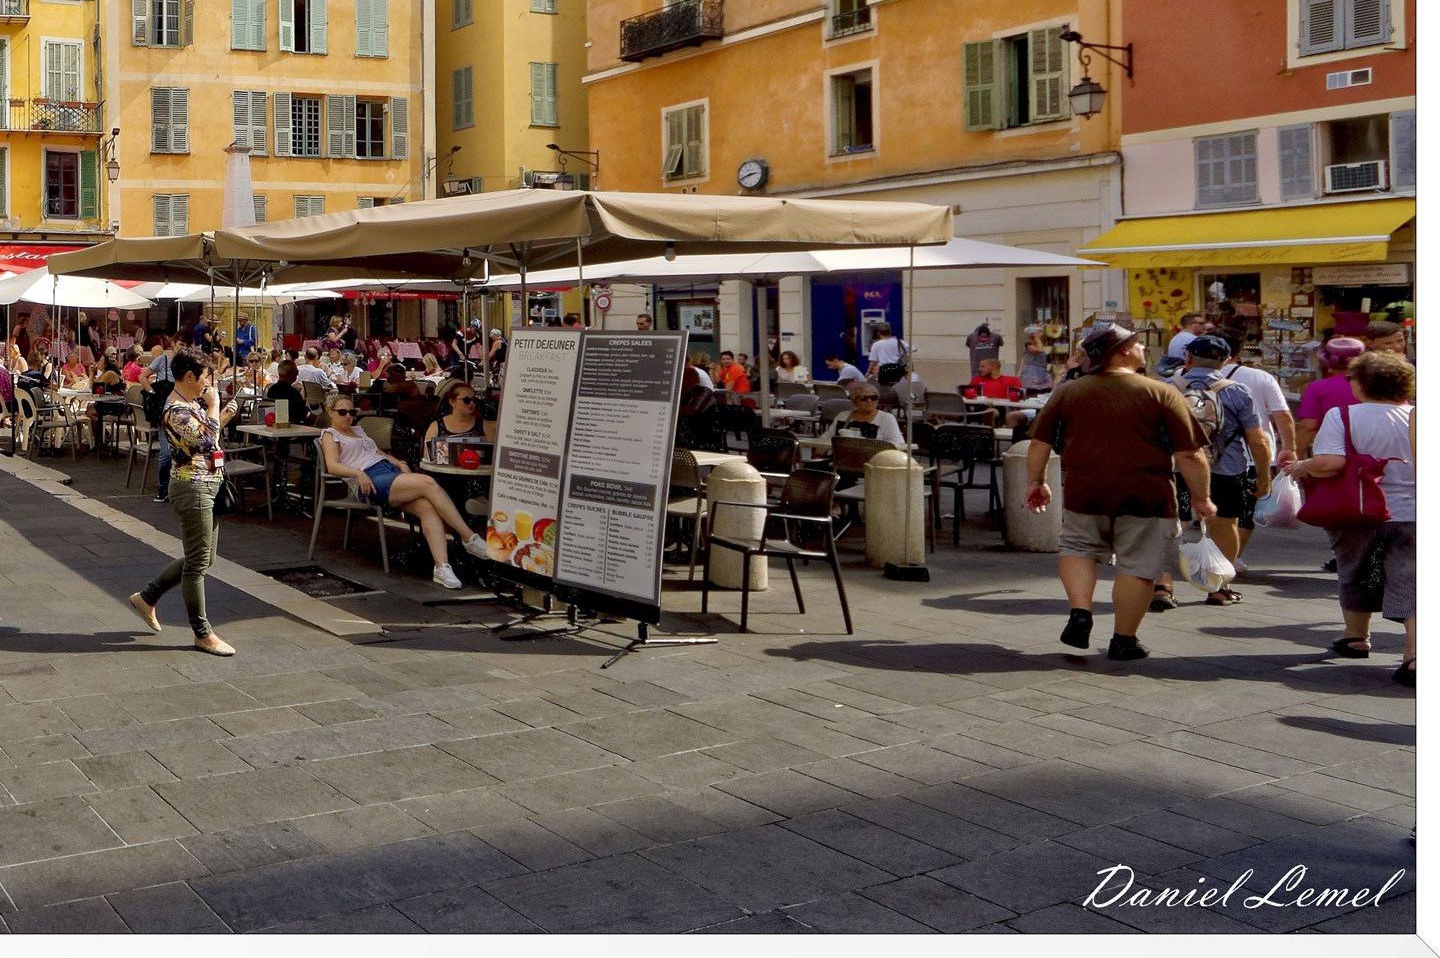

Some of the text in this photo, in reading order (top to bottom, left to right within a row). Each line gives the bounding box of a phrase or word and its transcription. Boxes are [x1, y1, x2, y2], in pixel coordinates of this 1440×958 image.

[514, 339, 576, 350] PETIT DEJEUNER
[519, 350, 566, 363] BREAKFAST
[606, 483, 623, 491] BOWL
[612, 510, 632, 518] BUBBLE
